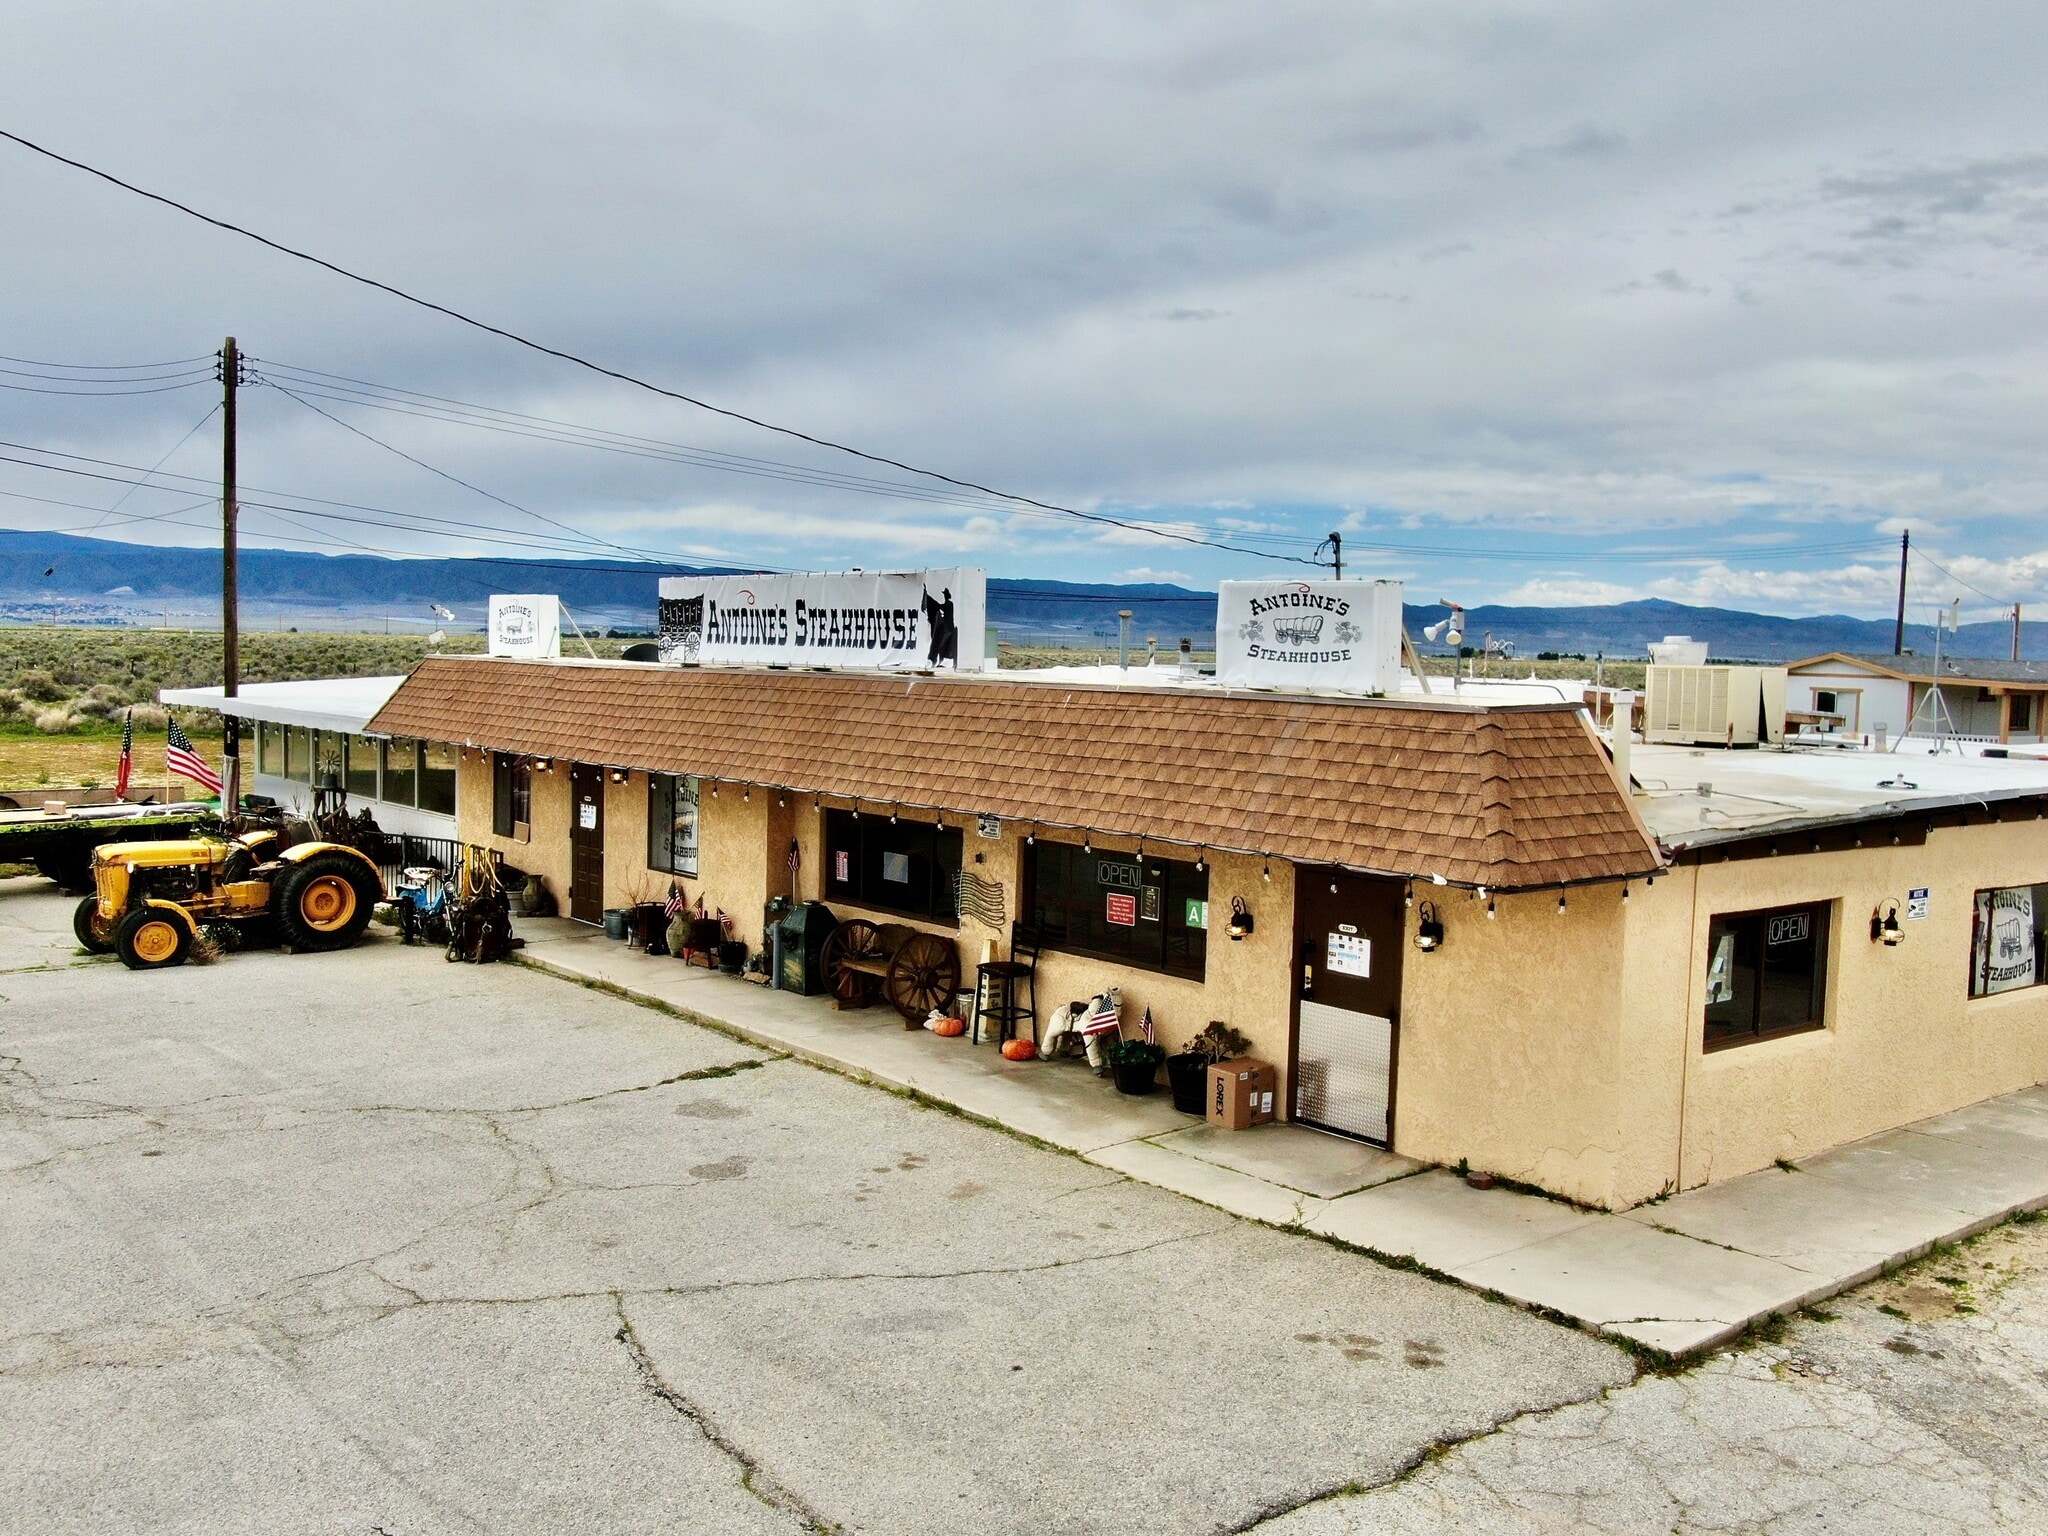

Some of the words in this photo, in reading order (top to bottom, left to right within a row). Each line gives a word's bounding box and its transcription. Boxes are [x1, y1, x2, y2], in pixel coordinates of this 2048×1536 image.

[499, 605, 532, 618] ANTOINE'S
[1249, 593, 1350, 616] ANTOINE'S
[706, 599, 787, 646] ANTOINE'S
[795, 599, 918, 649] STEAKHOUSE
[499, 634, 533, 645] STEAKHOUSE
[1247, 644, 1352, 664] STEAKHOUSE
[1100, 863, 1139, 886] OPEN
[1188, 906, 1199, 923] A
[1771, 915, 1808, 941] OPEN
[1216, 1076, 1225, 1118] LOREX
